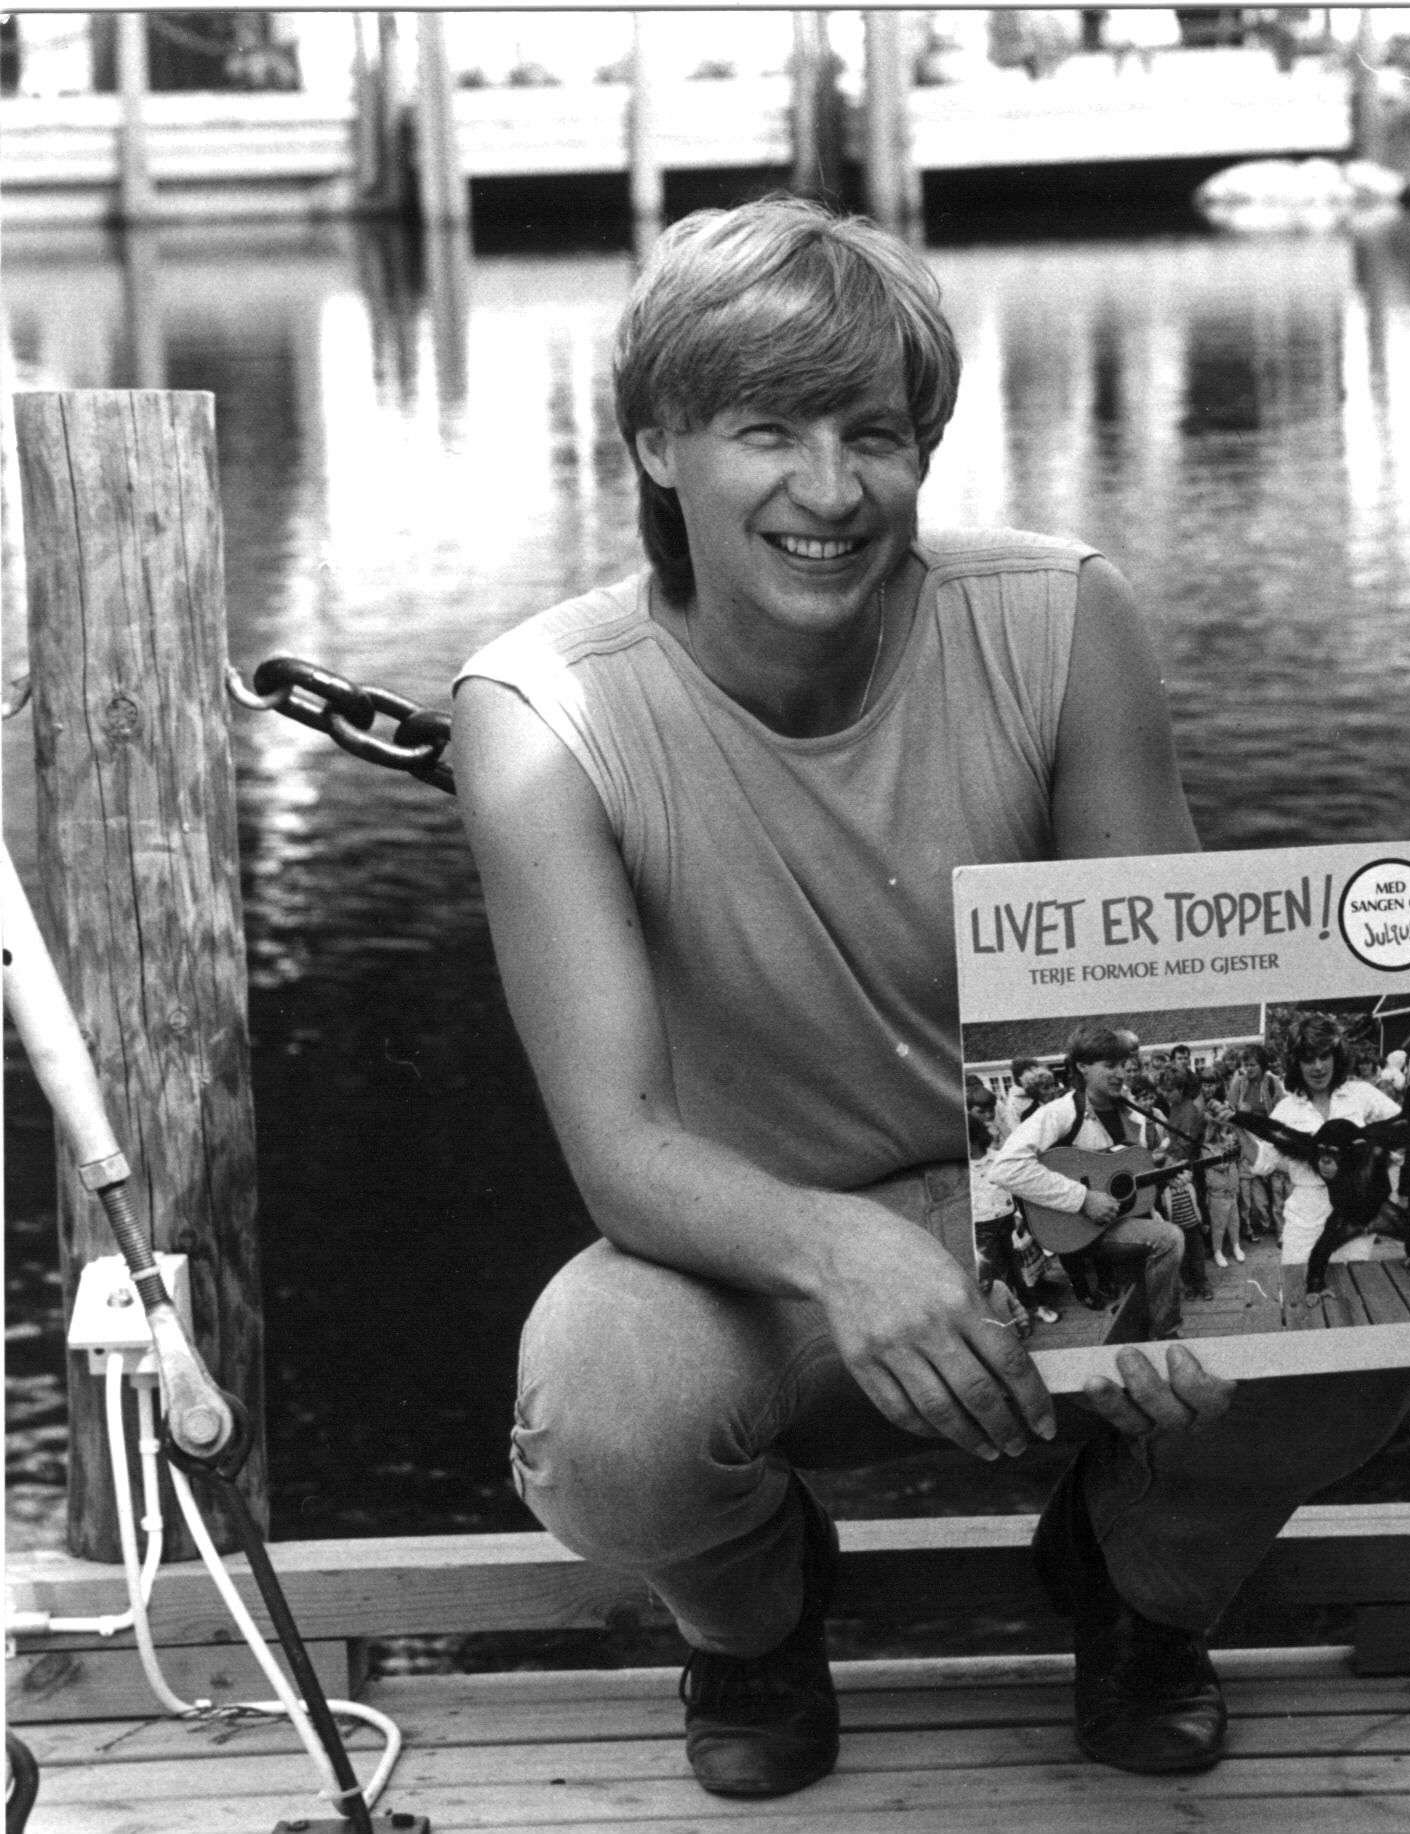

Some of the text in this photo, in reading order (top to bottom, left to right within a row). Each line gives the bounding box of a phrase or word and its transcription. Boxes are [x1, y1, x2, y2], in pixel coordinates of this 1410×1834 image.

[1376, 881, 1406, 894] MED
[971, 874, 1333, 956] LIVET ER TOPPEN!
[1350, 898, 1405, 913] SANGEN
[1028, 953, 1280, 986] TERJE FORMOE MED GJESTER
